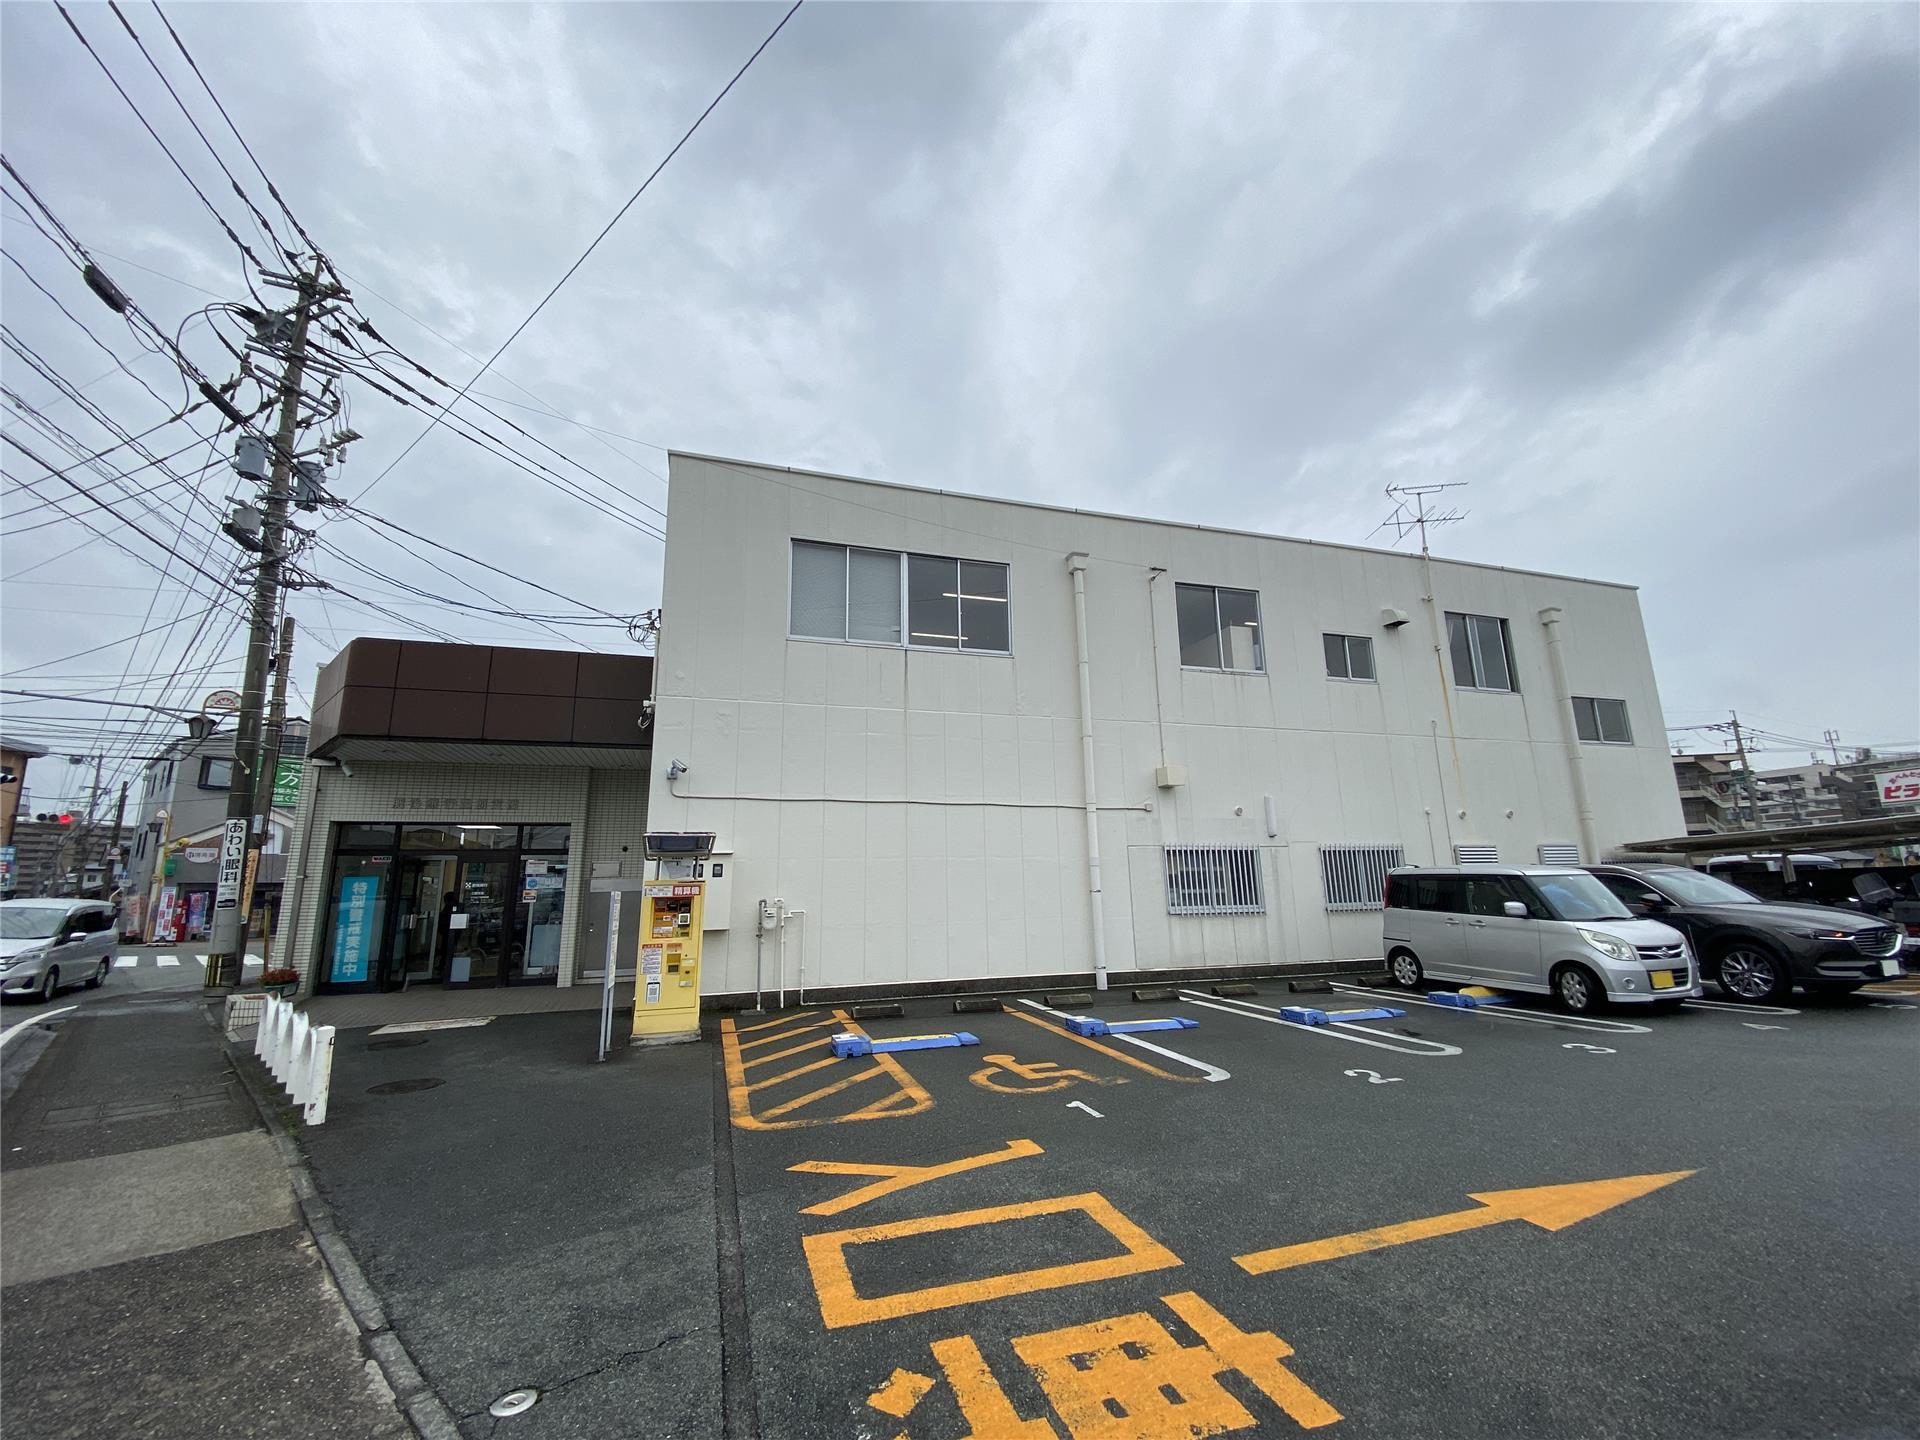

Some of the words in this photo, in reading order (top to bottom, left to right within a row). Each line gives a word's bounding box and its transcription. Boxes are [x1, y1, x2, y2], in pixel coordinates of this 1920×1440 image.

[223, 822, 244, 883] あわい眼科
[1562, 1043, 1617, 1054] 3
[1344, 1069, 1405, 1084] 2
[1065, 1101, 1105, 1118] 1
